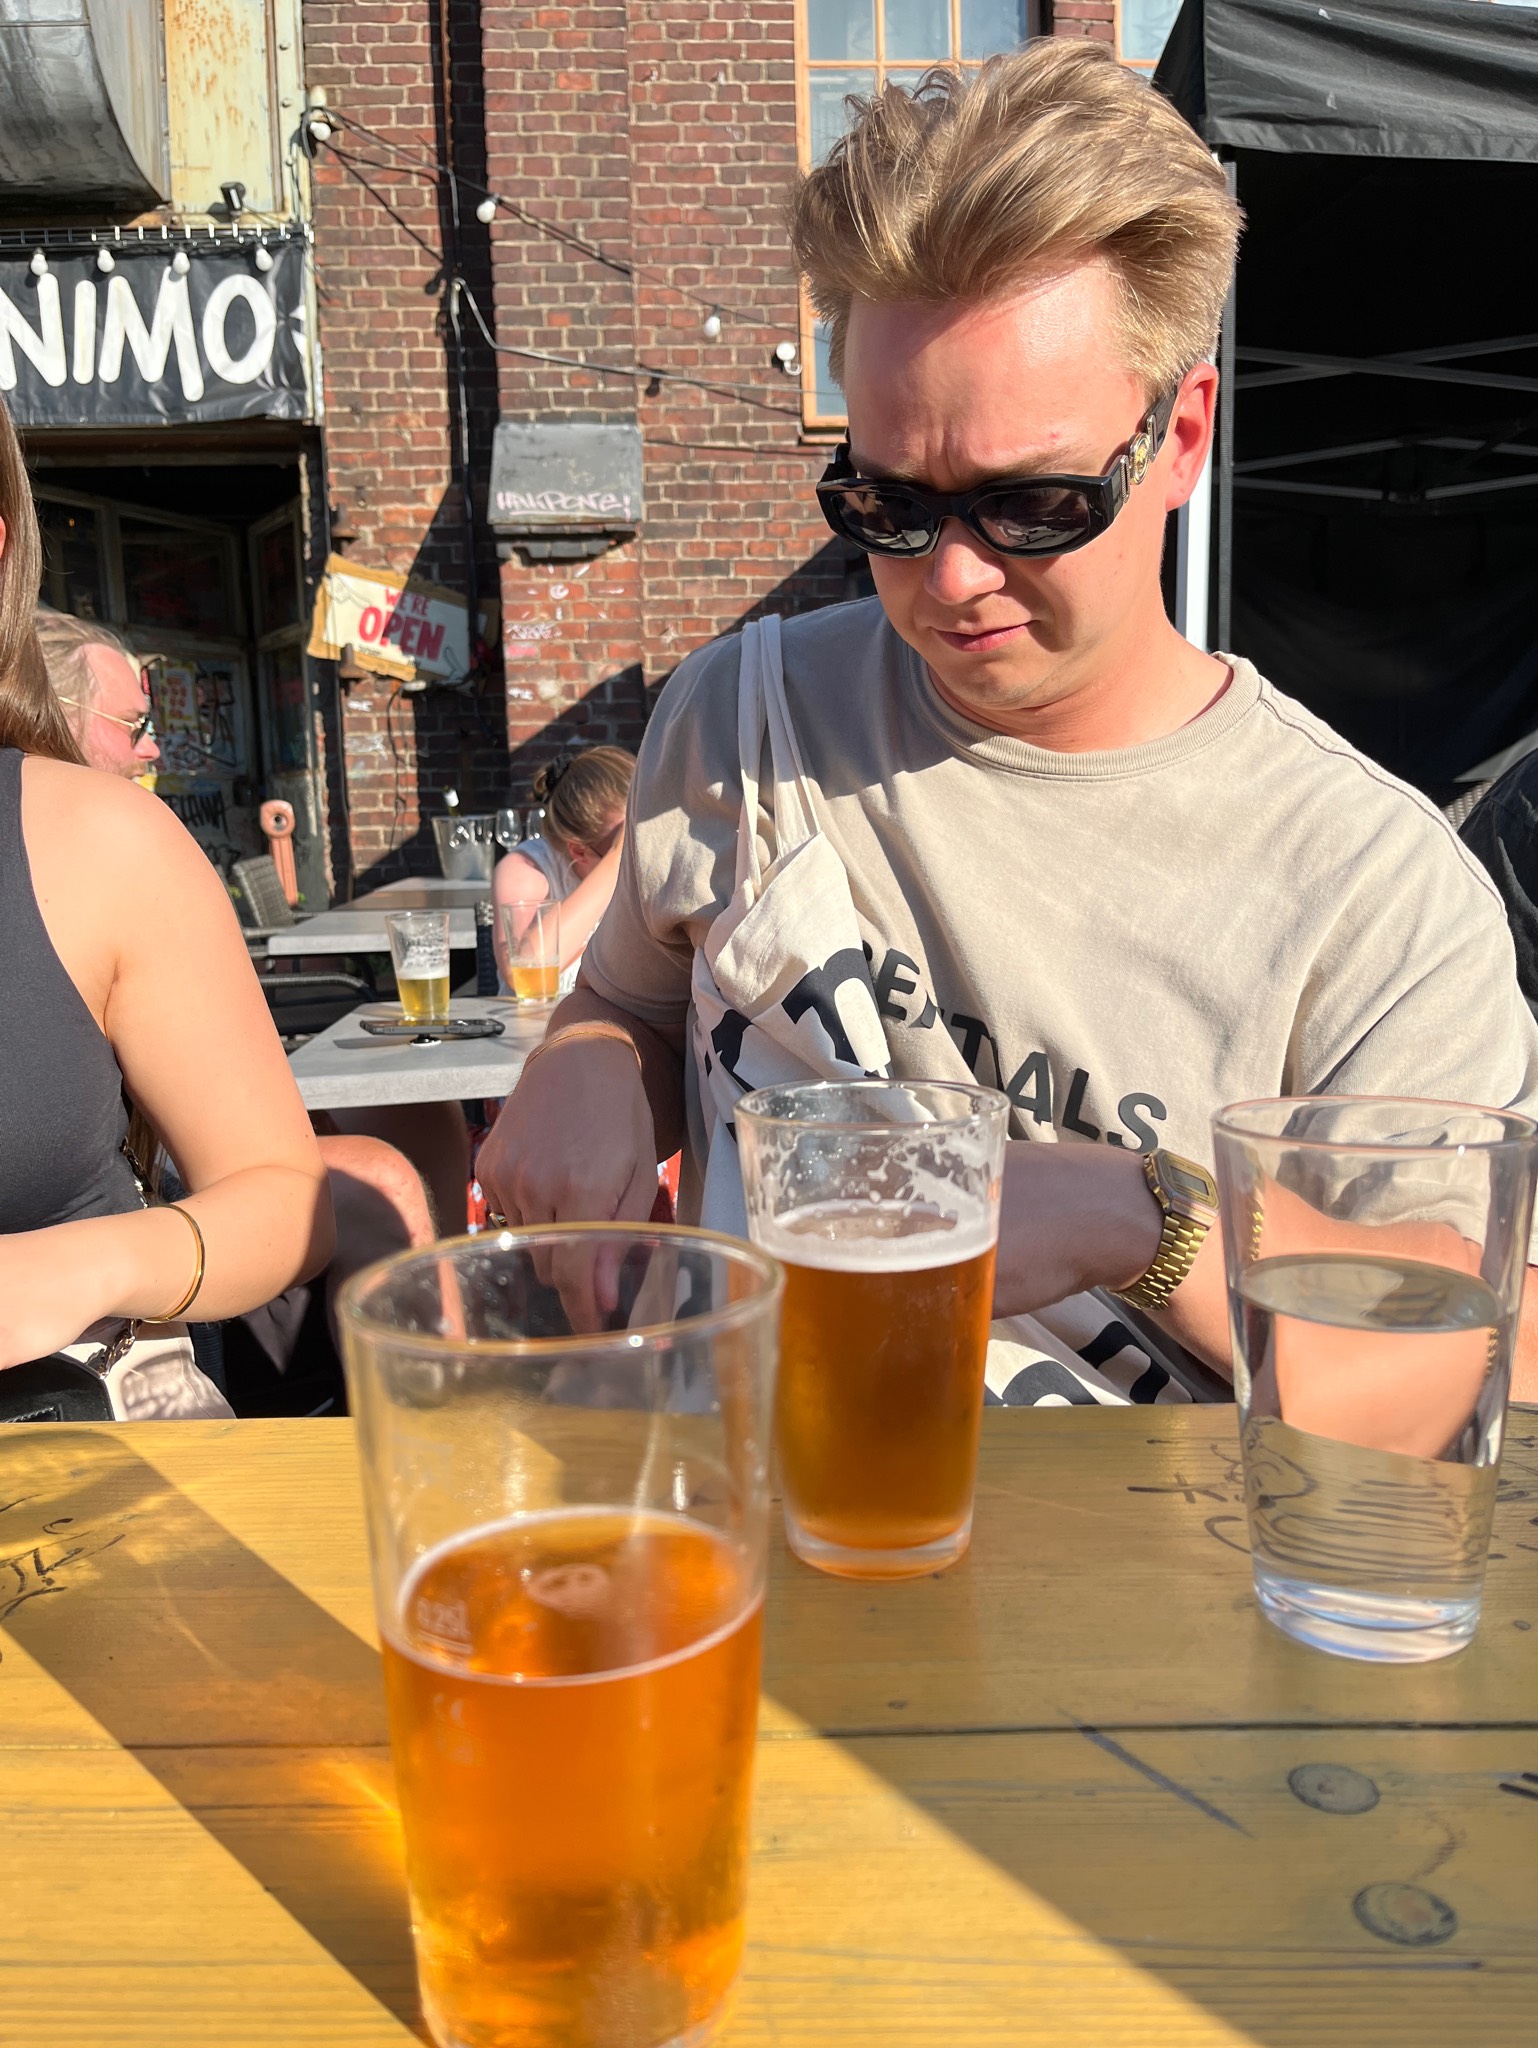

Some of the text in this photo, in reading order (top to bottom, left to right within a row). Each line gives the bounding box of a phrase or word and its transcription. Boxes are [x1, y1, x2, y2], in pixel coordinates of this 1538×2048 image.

[0, 266, 277, 402] NIMO
[385, 587, 431, 616] WE'RE
[359, 606, 446, 662] OPEN
